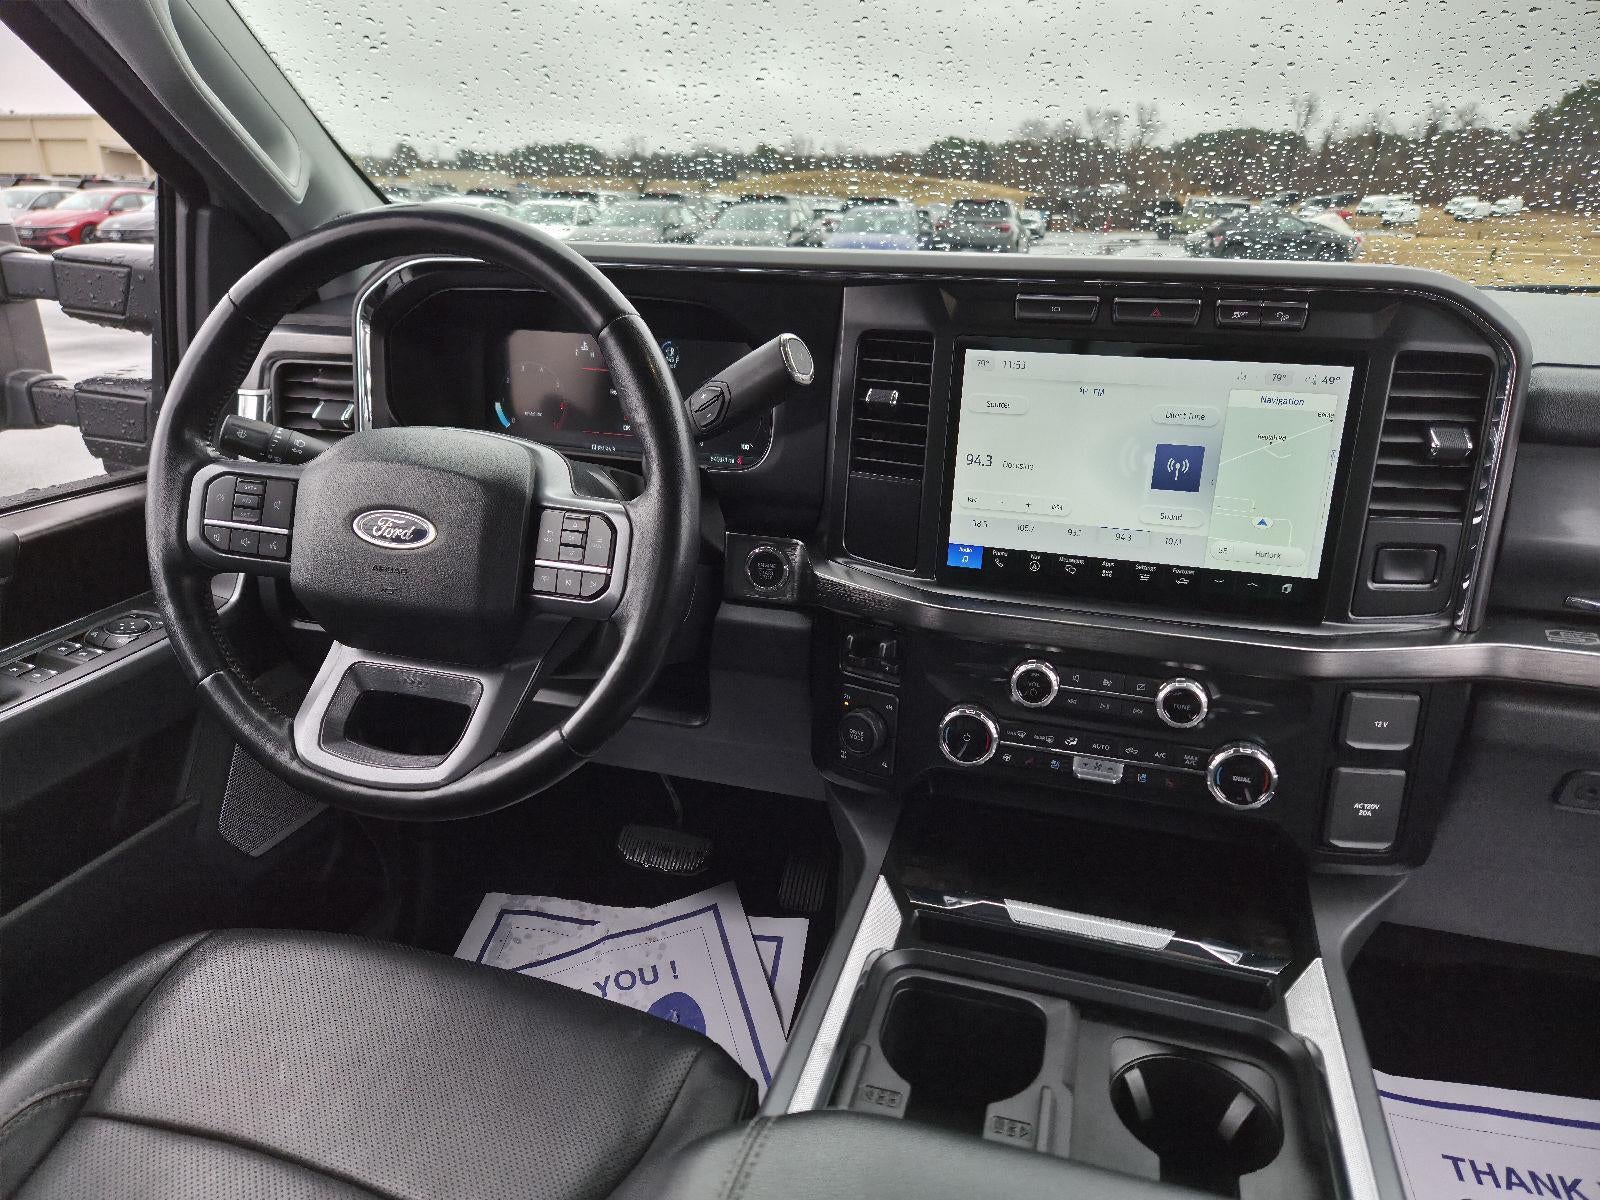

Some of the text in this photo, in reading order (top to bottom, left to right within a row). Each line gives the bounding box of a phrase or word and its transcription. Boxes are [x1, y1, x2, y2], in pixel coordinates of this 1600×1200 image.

[1321, 376, 1341, 385] 49°
[1260, 395, 1305, 406] Navigation
[966, 453, 993, 467] 94.3
[1173, 703, 1191, 711] TUNE
[1092, 743, 1110, 751] AUTO
[1154, 751, 1167, 759] A/C
[1232, 775, 1252, 783] DUAL
[1441, 1153, 1590, 1200] THANK
